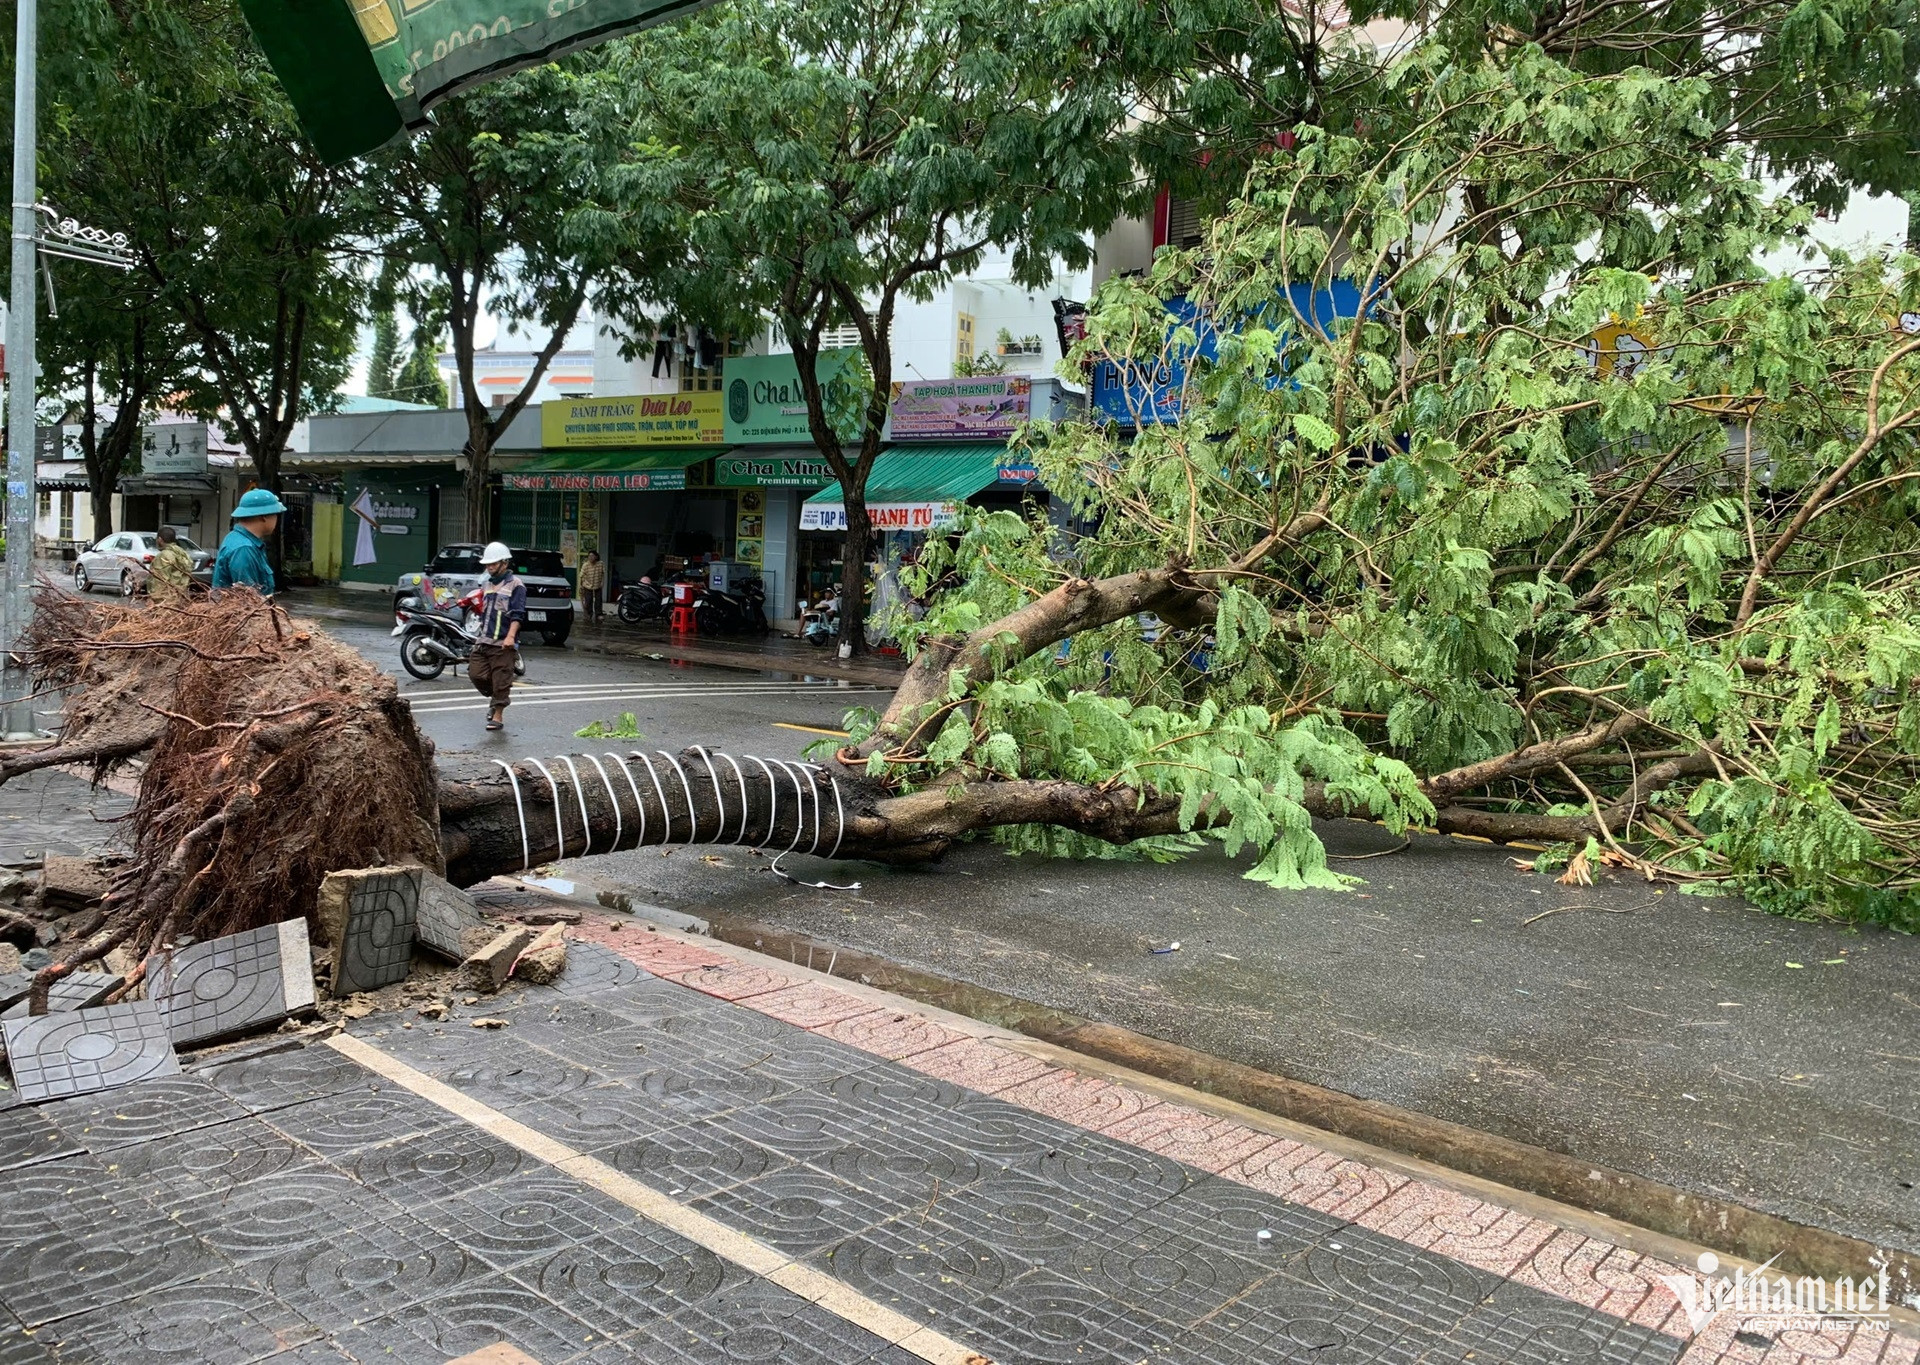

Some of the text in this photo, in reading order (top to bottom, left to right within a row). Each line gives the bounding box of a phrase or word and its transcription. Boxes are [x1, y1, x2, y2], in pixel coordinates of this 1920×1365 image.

[957, 385, 989, 395] THANH
[669, 396, 692, 415] Leo
[731, 460, 838, 482] Cha Ming
[757, 477, 818, 485] Premium tea
[820, 511, 836, 528] TẠP
[866, 509, 909, 526] HANH
[912, 504, 933, 526] TÚ
